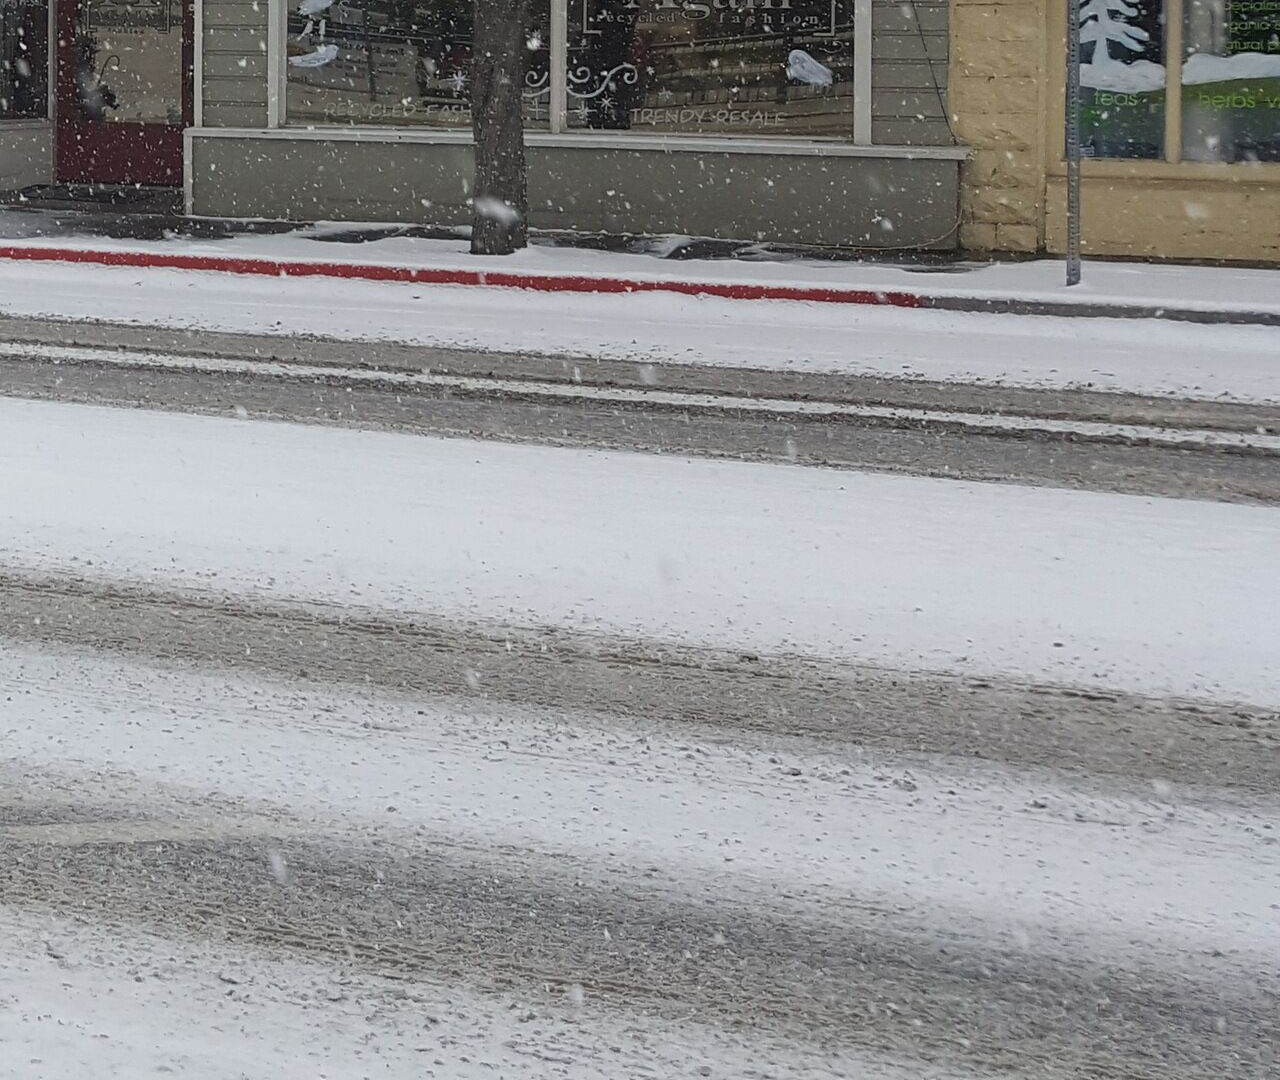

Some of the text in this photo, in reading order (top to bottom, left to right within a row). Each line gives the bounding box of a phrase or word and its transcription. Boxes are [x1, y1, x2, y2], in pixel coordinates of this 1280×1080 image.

[595, 12, 820, 25] recycled fashion
[1093, 89, 1139, 107] teas
[1198, 92, 1257, 109] herbs
[324, 101, 417, 118] RECYCLED
[630, 107, 788, 127] TRENDY RESALE
